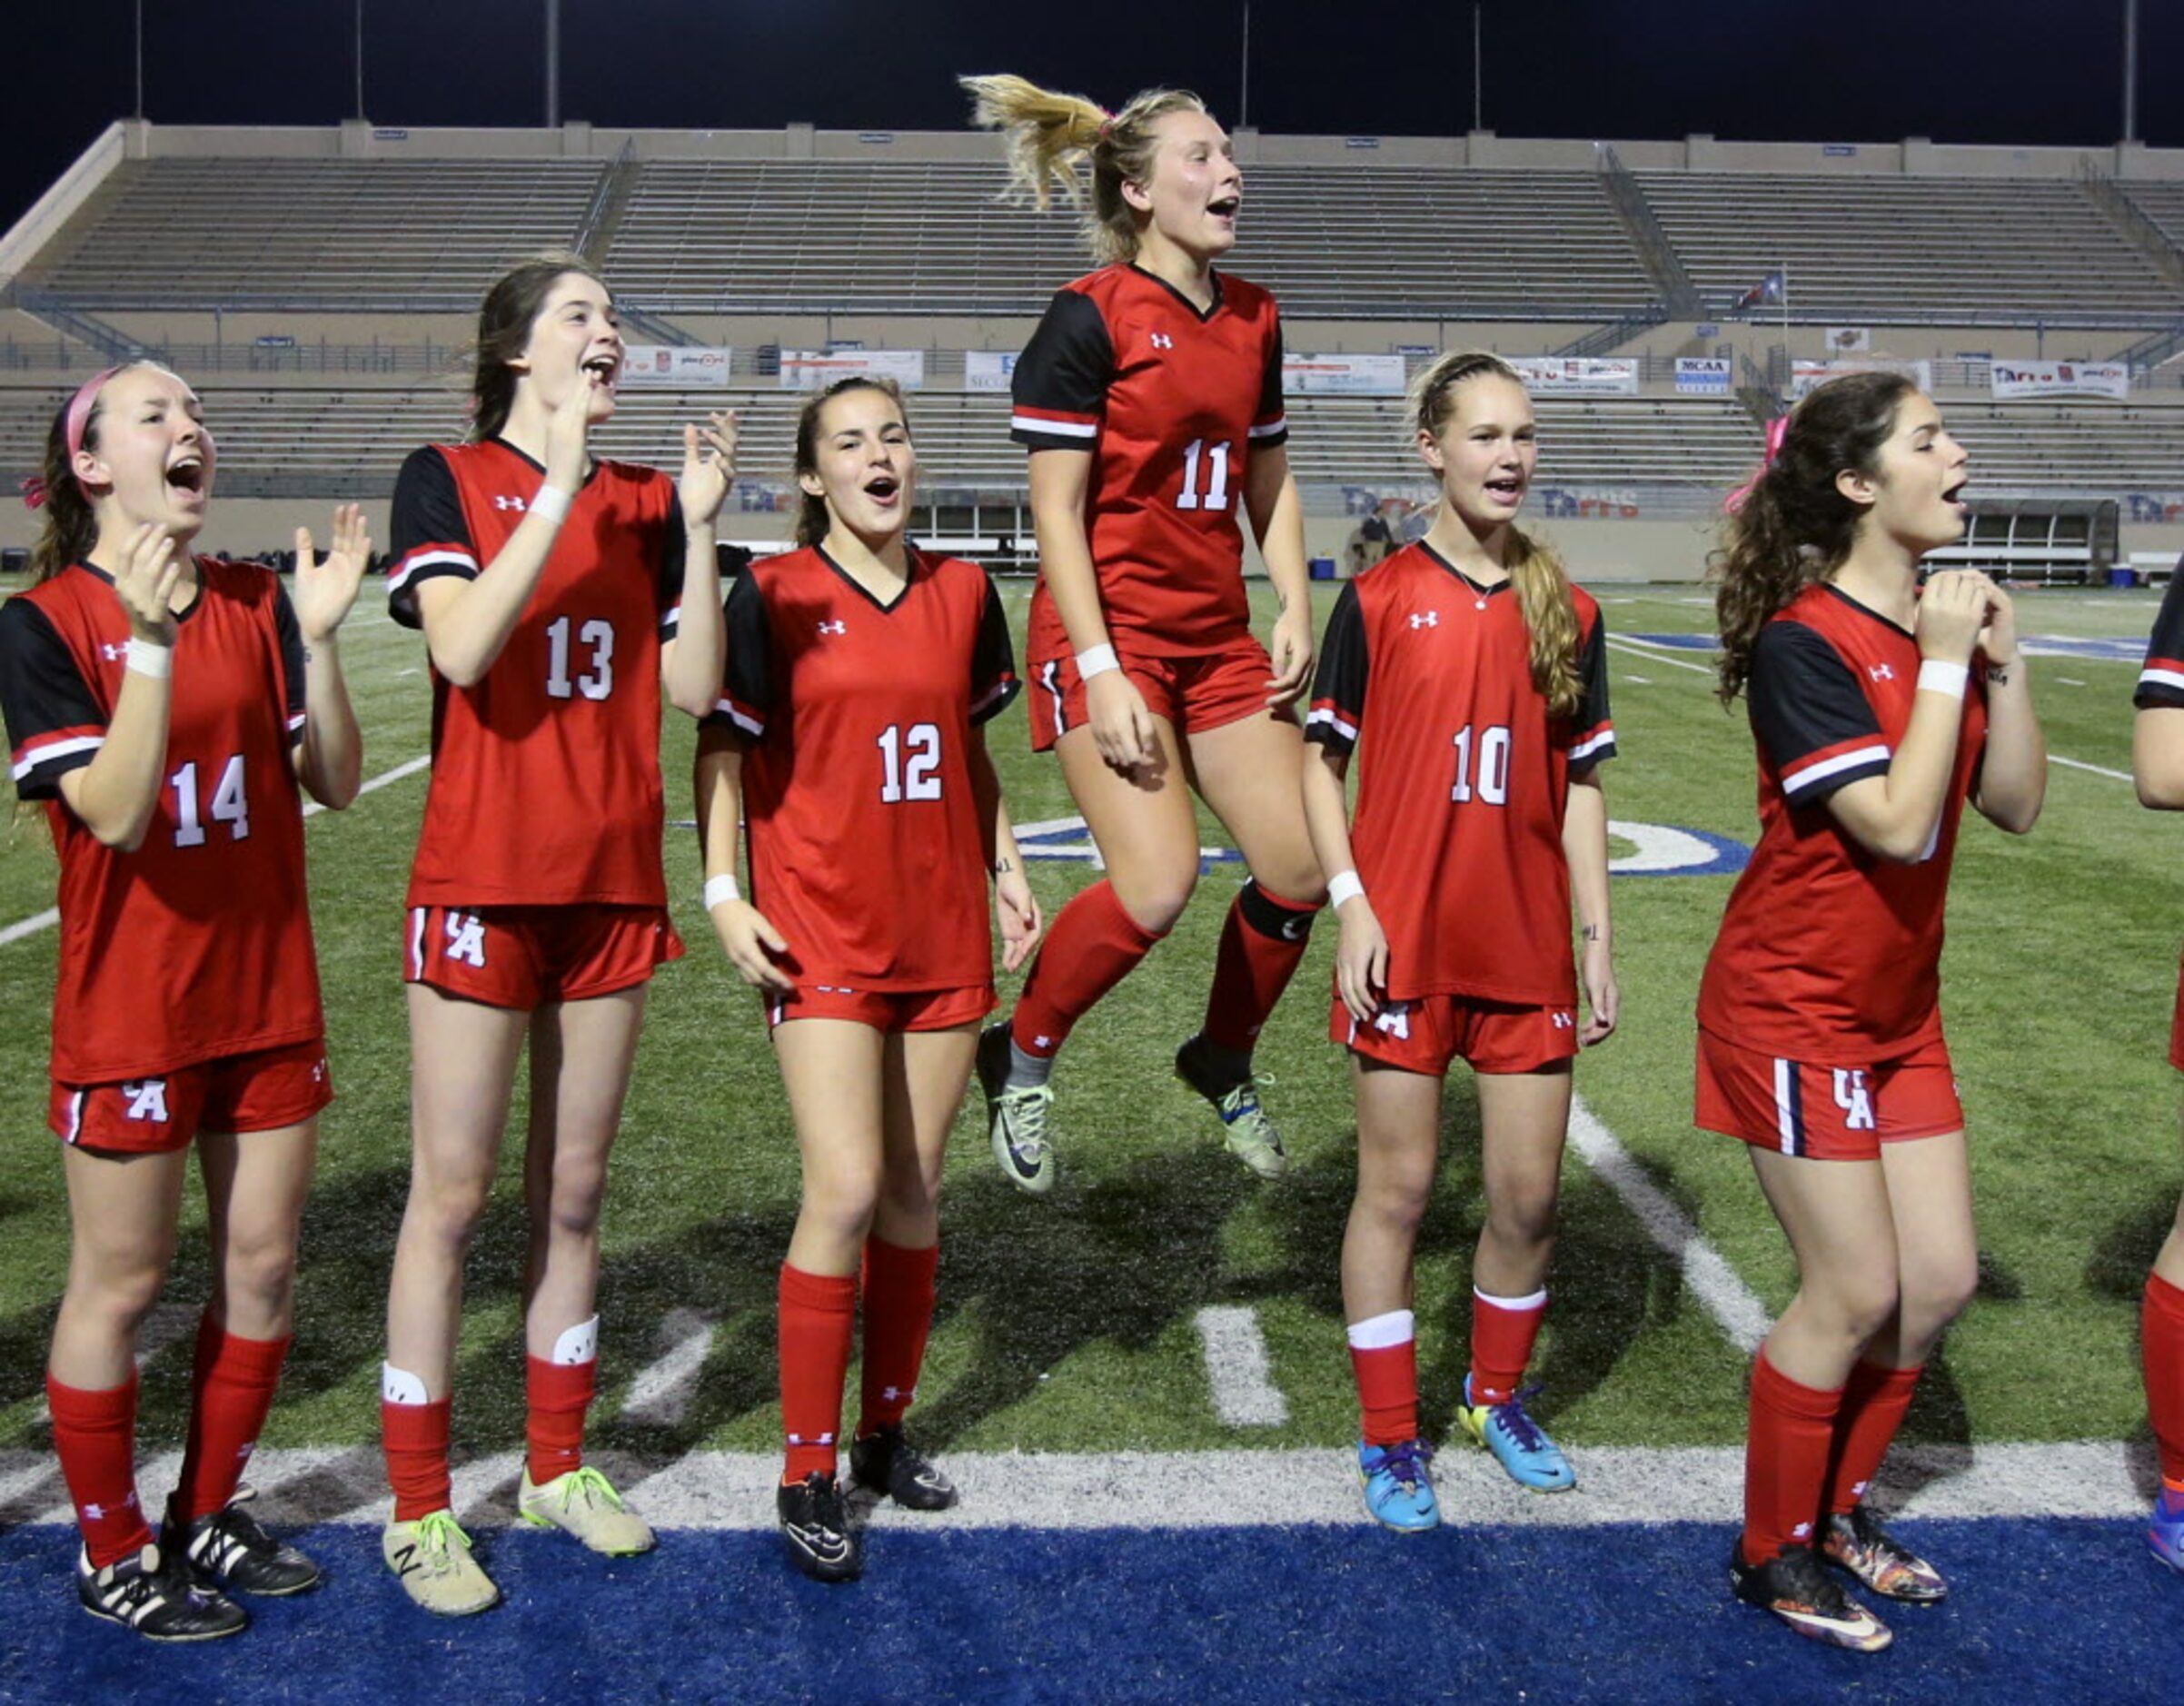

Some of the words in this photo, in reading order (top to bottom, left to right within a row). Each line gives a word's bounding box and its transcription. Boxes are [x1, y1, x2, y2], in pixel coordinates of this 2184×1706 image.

[1682, 361, 1723, 372] MCAA
[1175, 439, 1230, 511] 11
[545, 616, 614, 701] 13
[169, 754, 249, 848] 14
[876, 723, 942, 804] 12
[1450, 724, 1512, 806] 10
[1832, 1067, 1877, 1130] UA
